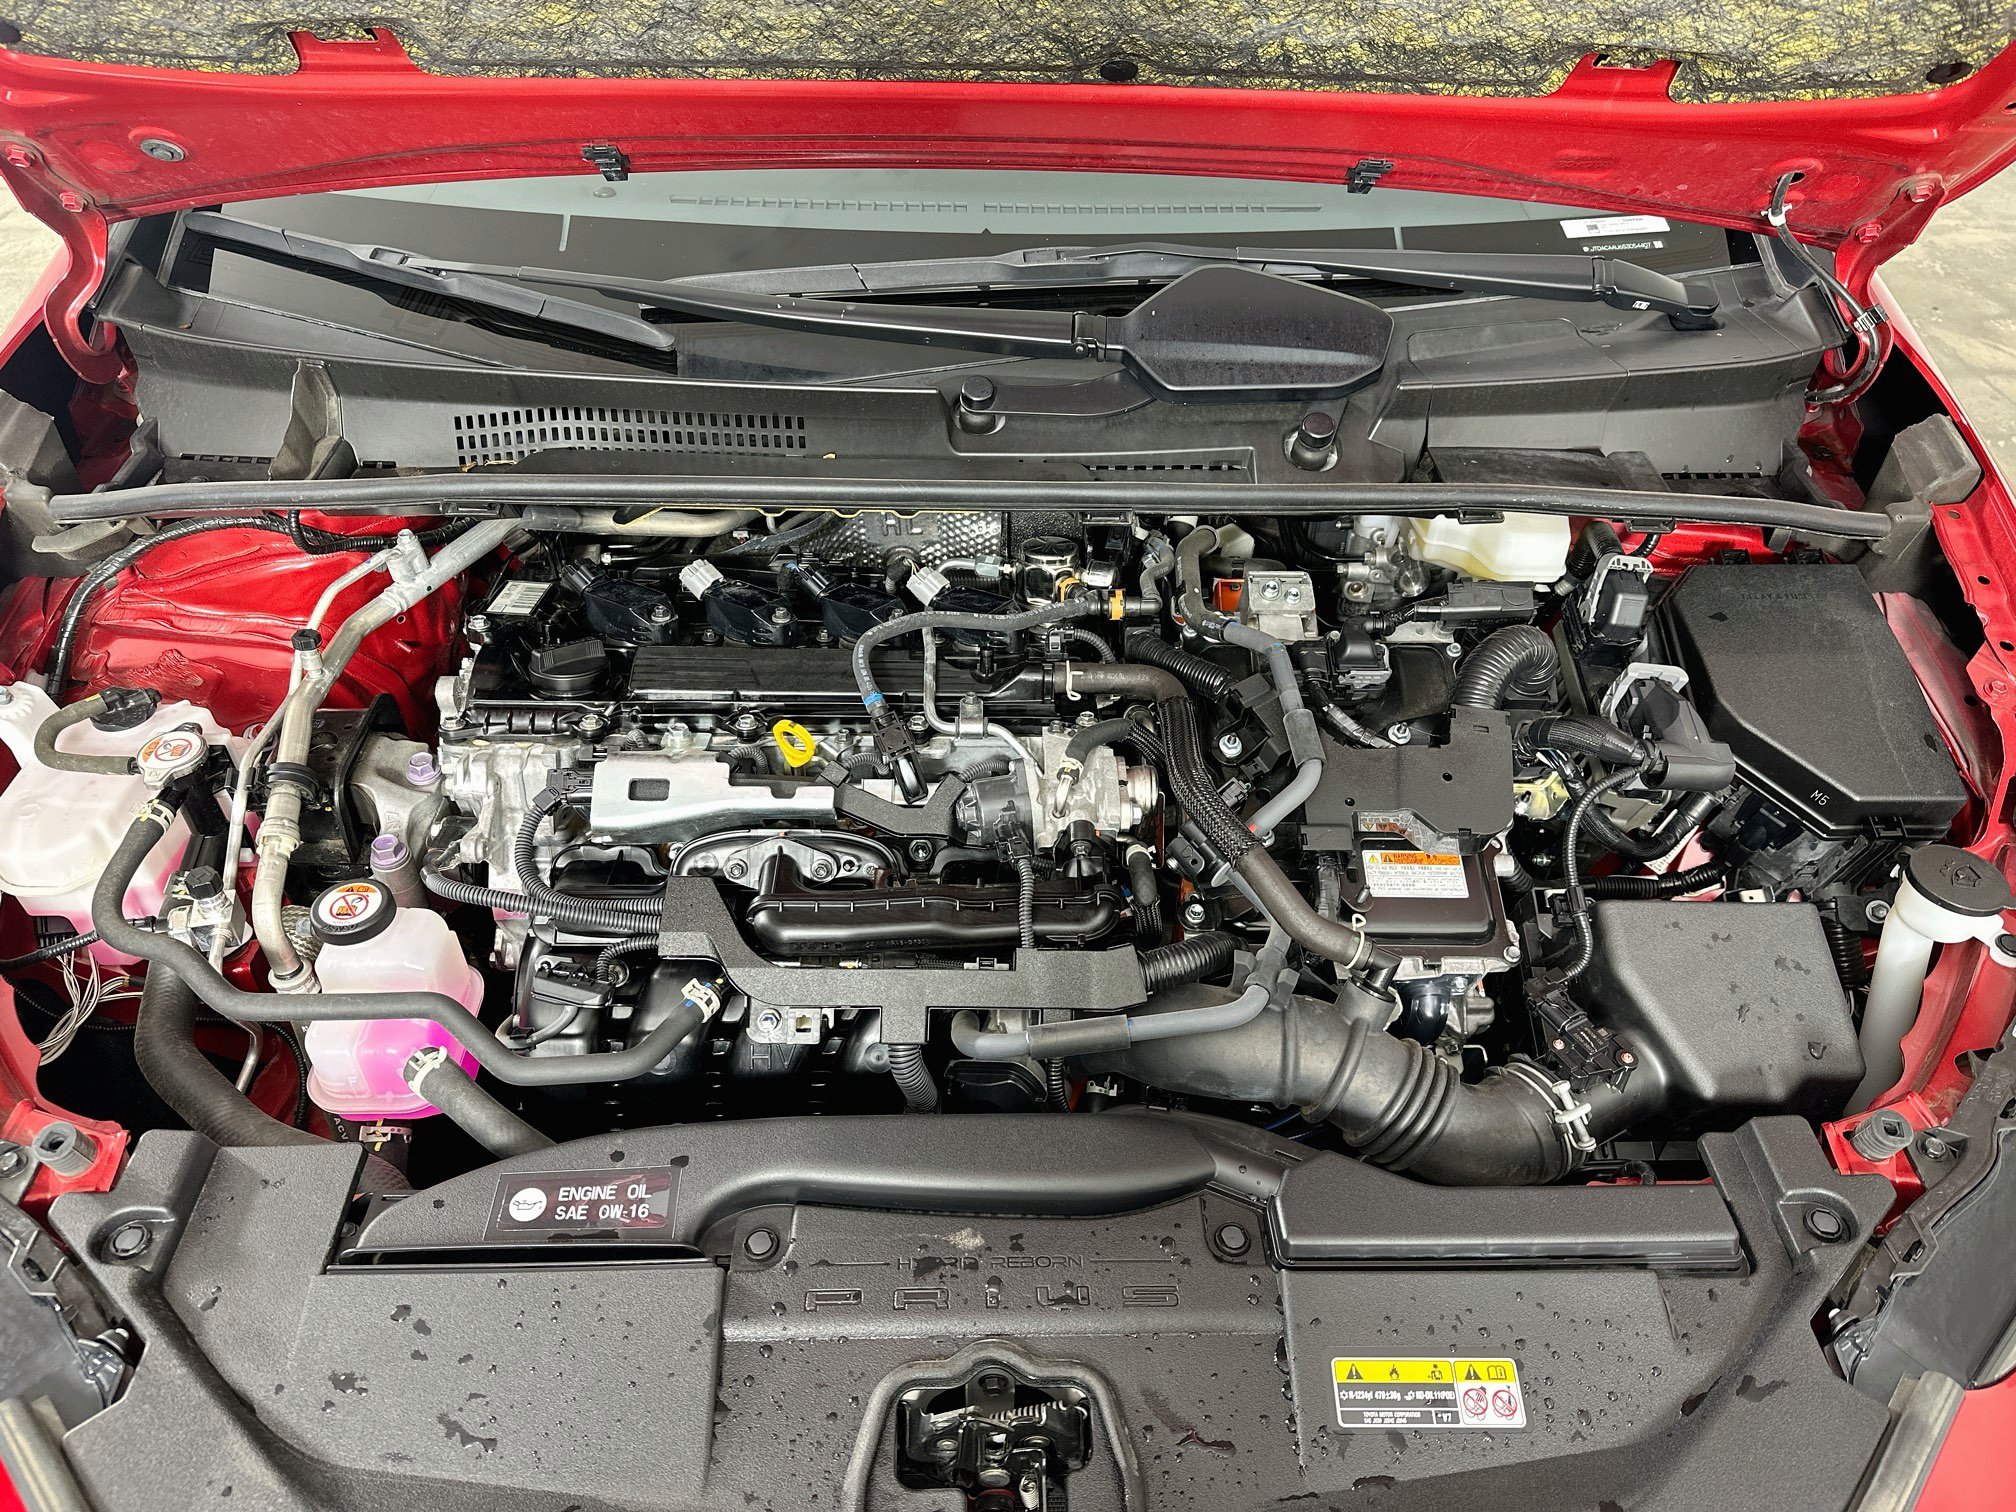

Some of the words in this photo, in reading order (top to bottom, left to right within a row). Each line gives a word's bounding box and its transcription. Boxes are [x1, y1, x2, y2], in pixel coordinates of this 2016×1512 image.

[1810, 789, 1831, 806] M5
[750, 1044, 796, 1070] HV
[557, 1185, 618, 1201] ENGINE
[626, 1184, 652, 1199] OIL
[554, 1205, 589, 1220] SAE
[598, 1203, 650, 1220] 0W-16
[991, 1255, 1084, 1269] REBORN
[804, 1285, 1180, 1312] PRIUS
